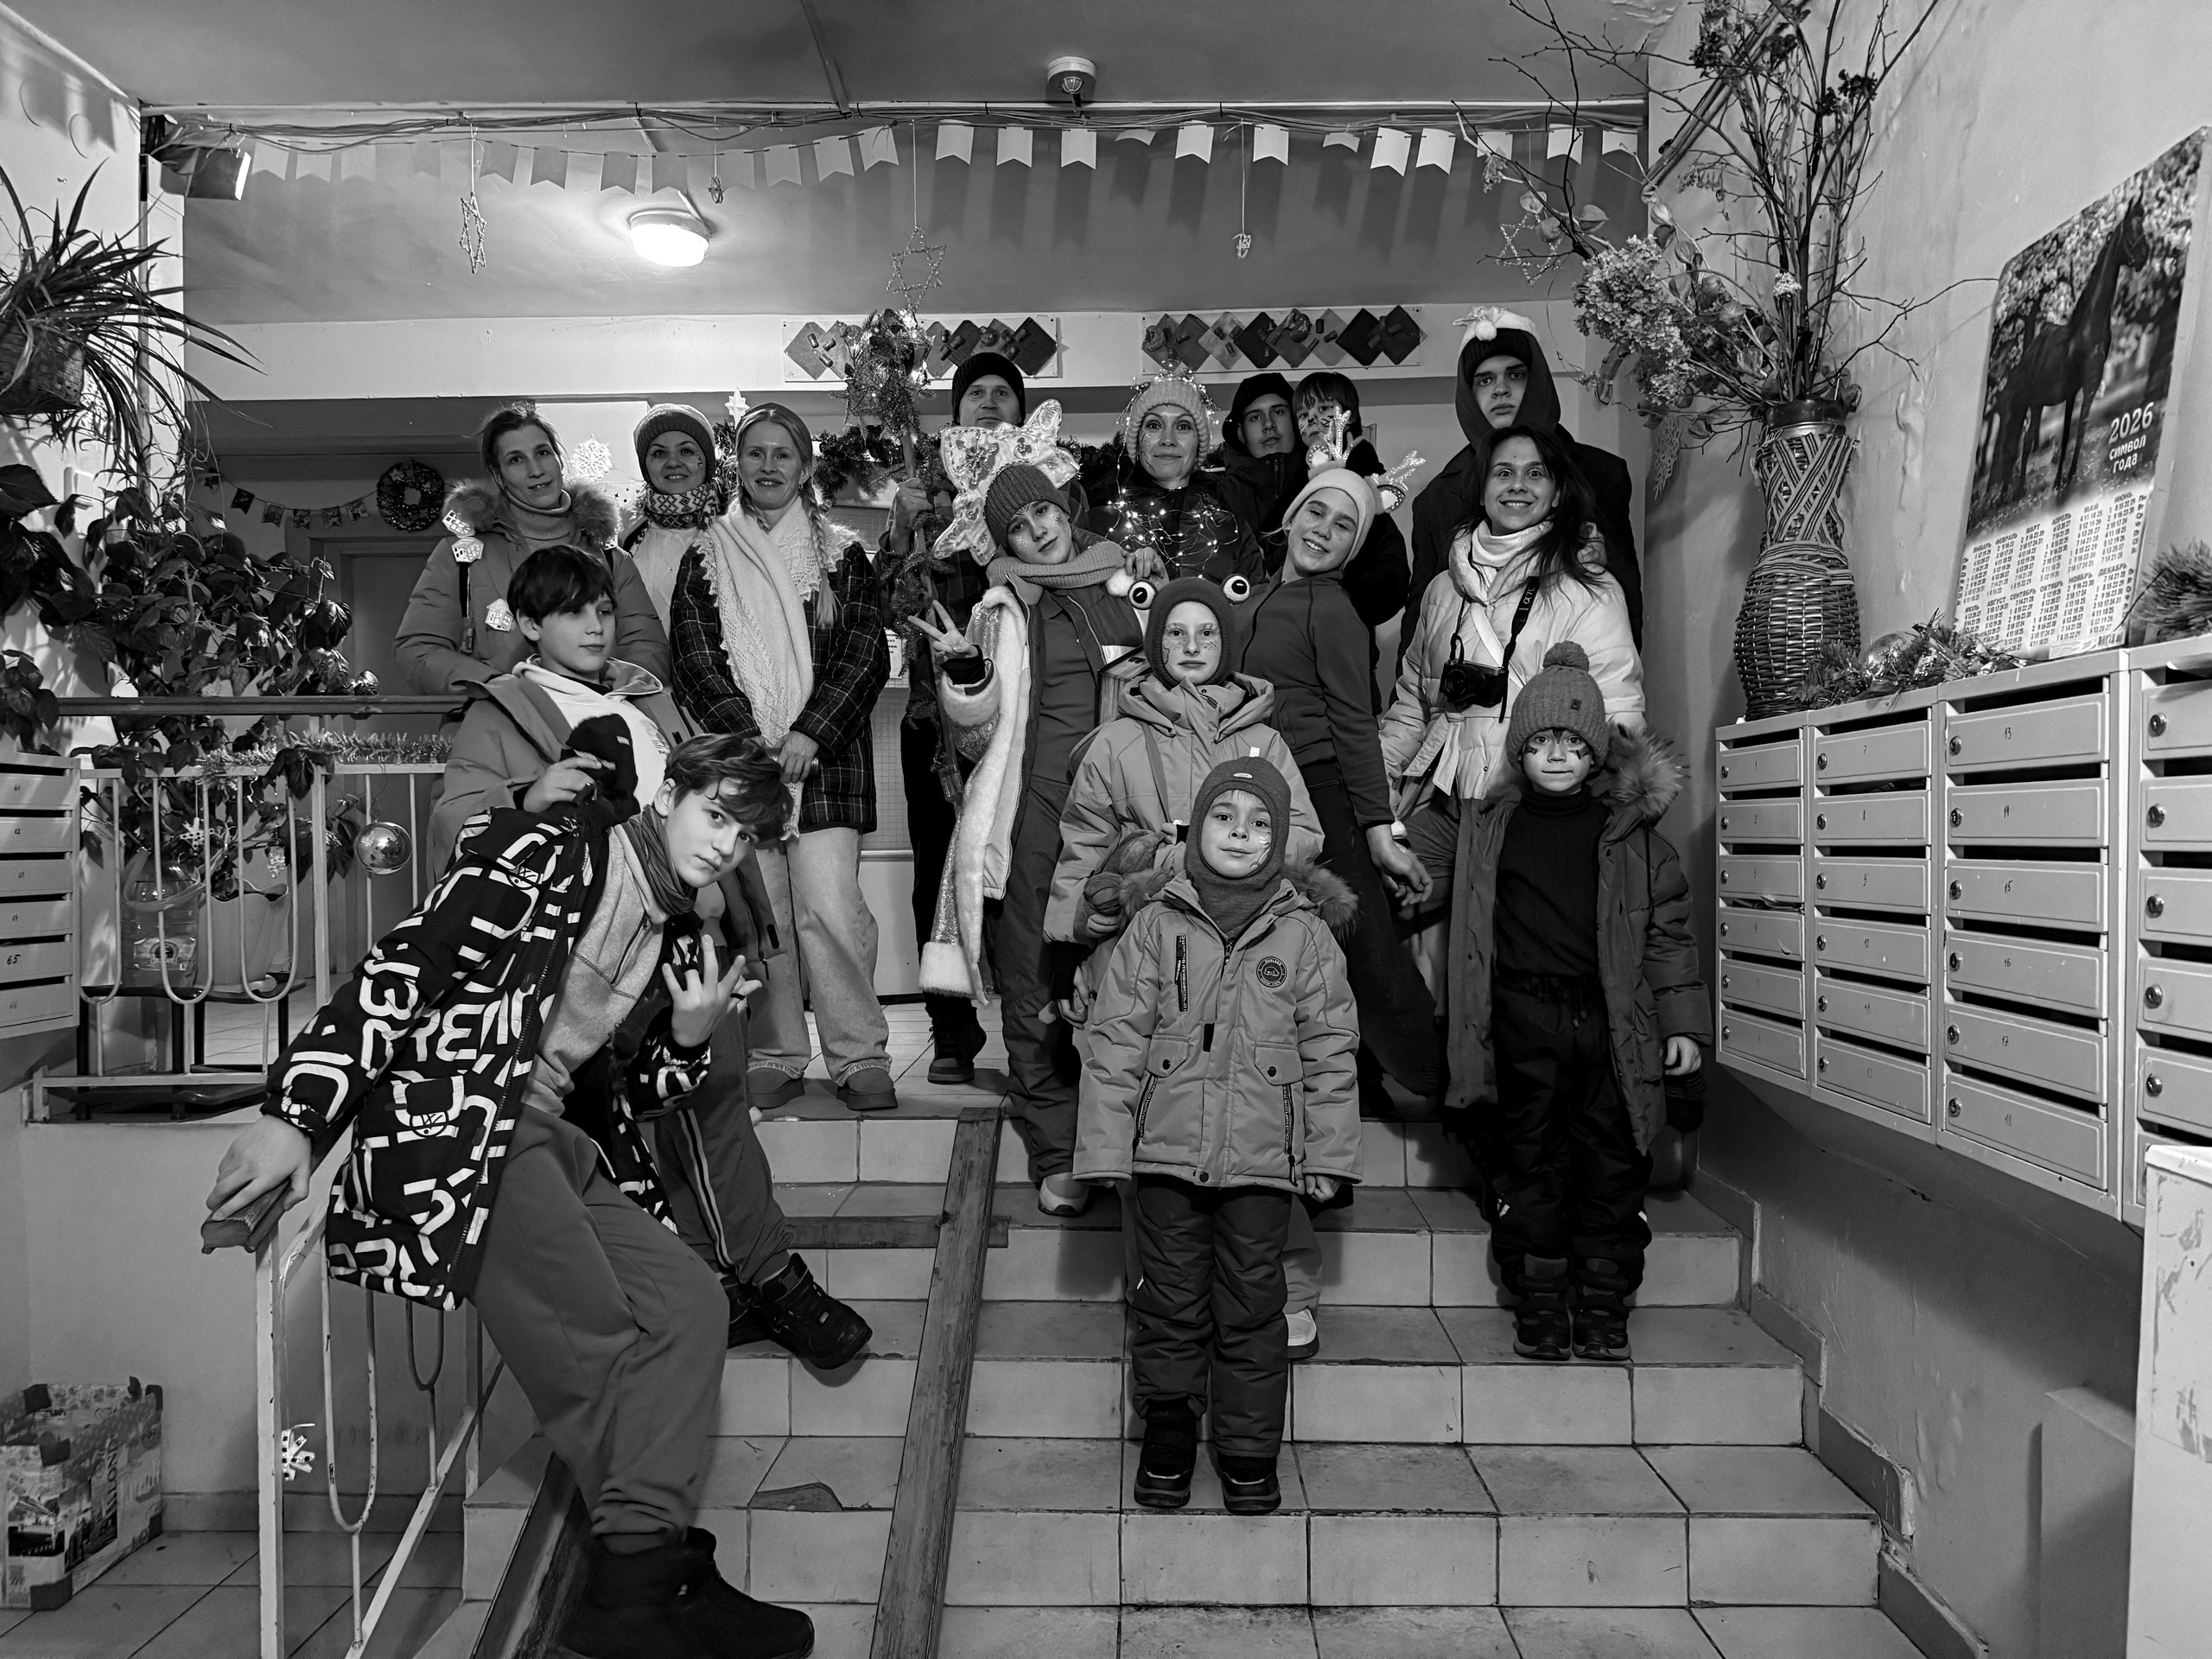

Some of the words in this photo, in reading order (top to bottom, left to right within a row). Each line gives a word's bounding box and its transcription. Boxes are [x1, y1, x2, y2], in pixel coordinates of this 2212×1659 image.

[2109, 402, 2154, 445] 2026
[2109, 435, 2146, 461] символ
[2113, 453, 2138, 474] года
[2084, 503, 2098, 512] МАЙ
[2026, 524, 2040, 533] МАРТ
[2098, 563, 2126, 576] ДЕКАБРЬ
[2069, 572, 2092, 583] НОЯБРЬ
[2040, 581, 2063, 592] ОКТЯБРЬ
[2011, 588, 2036, 600] СЕНТЯБРЬ
[1987, 597, 2005, 607] АВГУСТ
[2004, 727, 2012, 741] 13
[2004, 880, 2014, 893] 15
[7, 954, 21, 965] 65
[2004, 957, 2012, 969] 16
[2004, 1113, 2012, 1127] 18
